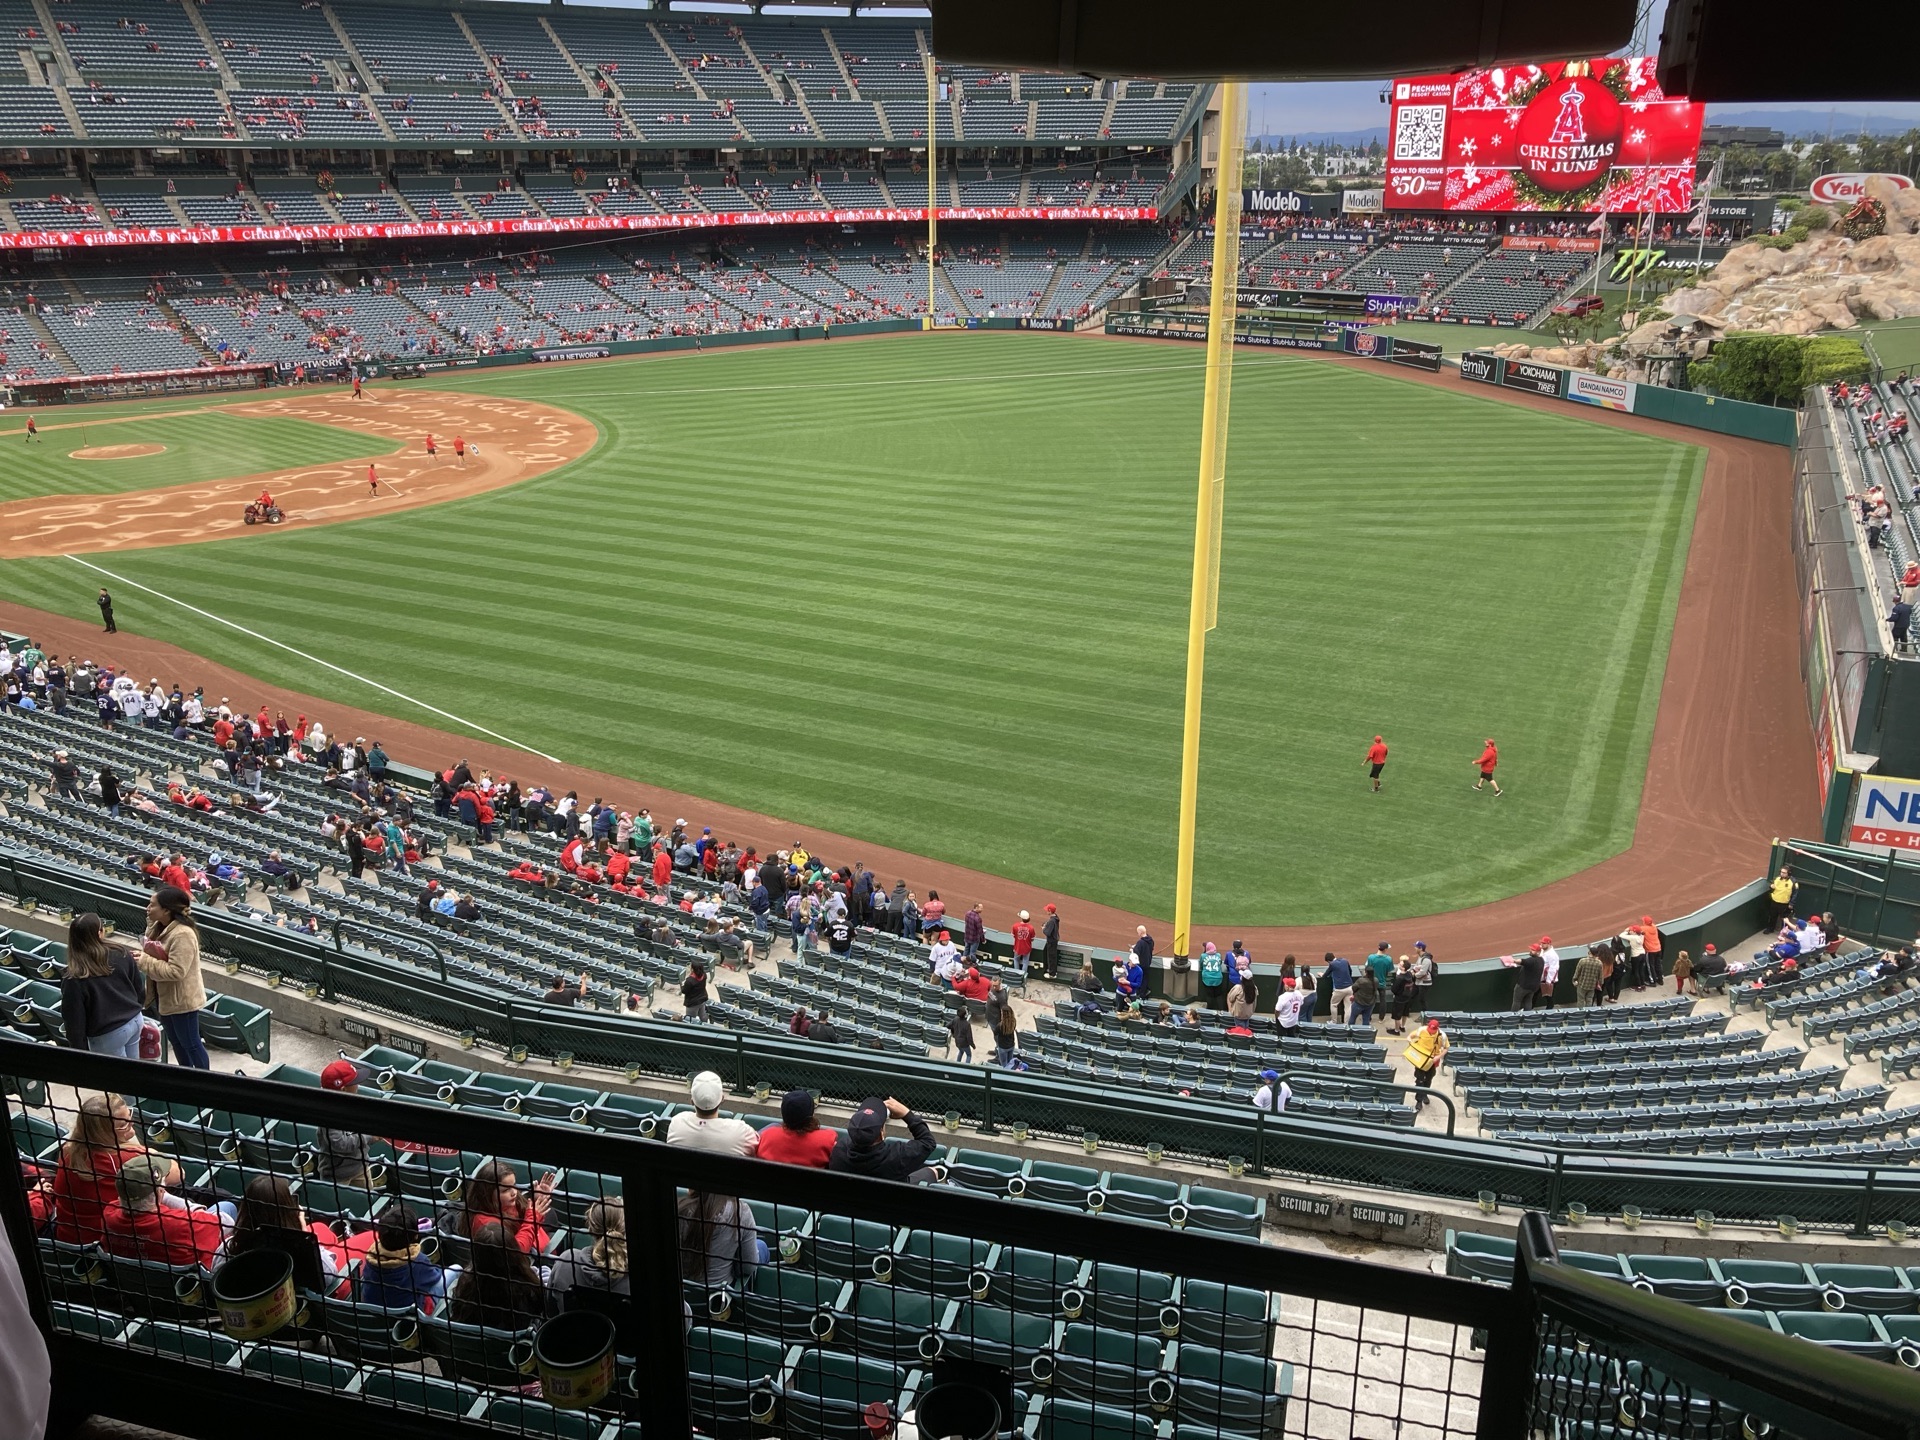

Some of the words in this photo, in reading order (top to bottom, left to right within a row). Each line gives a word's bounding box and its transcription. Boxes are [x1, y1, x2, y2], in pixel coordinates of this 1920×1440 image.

[1411, 84, 1451, 92] PECHANGA
[1520, 142, 1615, 160] CHRISTMAS
[1531, 159, 1548, 171] IN
[1552, 159, 1599, 173] JUNE
[1391, 175, 1426, 195] $50
[1829, 181, 1866, 197] Yak
[1251, 190, 1300, 211] Modelo
[1348, 193, 1379, 208] Modelo
[835, 211, 885, 222] CHRISTMAS
[887, 211, 899, 221] IN
[900, 210, 923, 221] JUNE
[938, 209, 991, 220] CHRISTMAS
[994, 209, 1004, 219] IN
[1006, 208, 1031, 219] JUNE
[1048, 209, 1100, 219] CHRISTMAS
[1103, 209, 1114, 219] IN
[1115, 208, 1140, 219] JUNE
[1697, 207, 1720, 216] TM
[1720, 207, 1748, 216] STORE
[628, 216, 681, 228] CHRISTMAS
[684, 216, 695, 226] IN
[697, 215, 719, 226] JUNE
[734, 214, 783, 225] CHRISTMAS
[784, 213, 795, 224] IN
[797, 212, 819, 223] JUNE
[385, 222, 448, 238] CHRISTMAS
[451, 223, 465, 234] IN
[466, 222, 495, 234] JUNE
[512, 221, 570, 233] CHRISTMAS
[572, 220, 584, 230] IN
[586, 219, 612, 230] JUNE
[84, 232, 163, 246] CHRISTMAS
[167, 231, 182, 243] IN
[186, 230, 220, 243] JUNE
[243, 228, 313, 240] CHRISTMAS
[316, 227, 331, 239] IN
[333, 227, 365, 238] JUNE
[20, 234, 58, 246] JUNE
[1508, 238, 1530, 248] Bally
[1556, 238, 1579, 250] Bally
[1657, 260, 1720, 269] MONS
[1029, 319, 1054, 330] Modelo
[1133, 328, 1158, 336] TIRE.COM
[1180, 331, 1207, 340] TIRE.COM
[1247, 336, 1271, 344] StubHub
[1272, 338, 1296, 347] StubHub
[1297, 340, 1322, 349] StubHub
[550, 353, 565, 362] MLB
[566, 350, 600, 361] NETWORK
[280, 362, 292, 371] LB
[1519, 364, 1558, 382] YOKOHAMA
[1537, 381, 1556, 394] TIRES
[1580, 380, 1601, 392] BANDAI
[1601, 383, 1624, 397] NAMCO
[125, 696, 136, 704] 44
[144, 702, 155, 711] 23
[1860, 830, 1888, 842] AC
[833, 929, 848, 941] 42
[1205, 961, 1219, 972] 44
[1292, 1003, 1299, 1014] 5
[345, 1020, 366, 1036] SECTION
[391, 1036, 412, 1051] SECTION
[415, 1142, 453, 1154] ANGES
[1280, 1196, 1313, 1213] SECTION
[1314, 1202, 1330, 1216] 347
[1353, 1206, 1386, 1223] SECTION
[1388, 1212, 1404, 1226] 348
